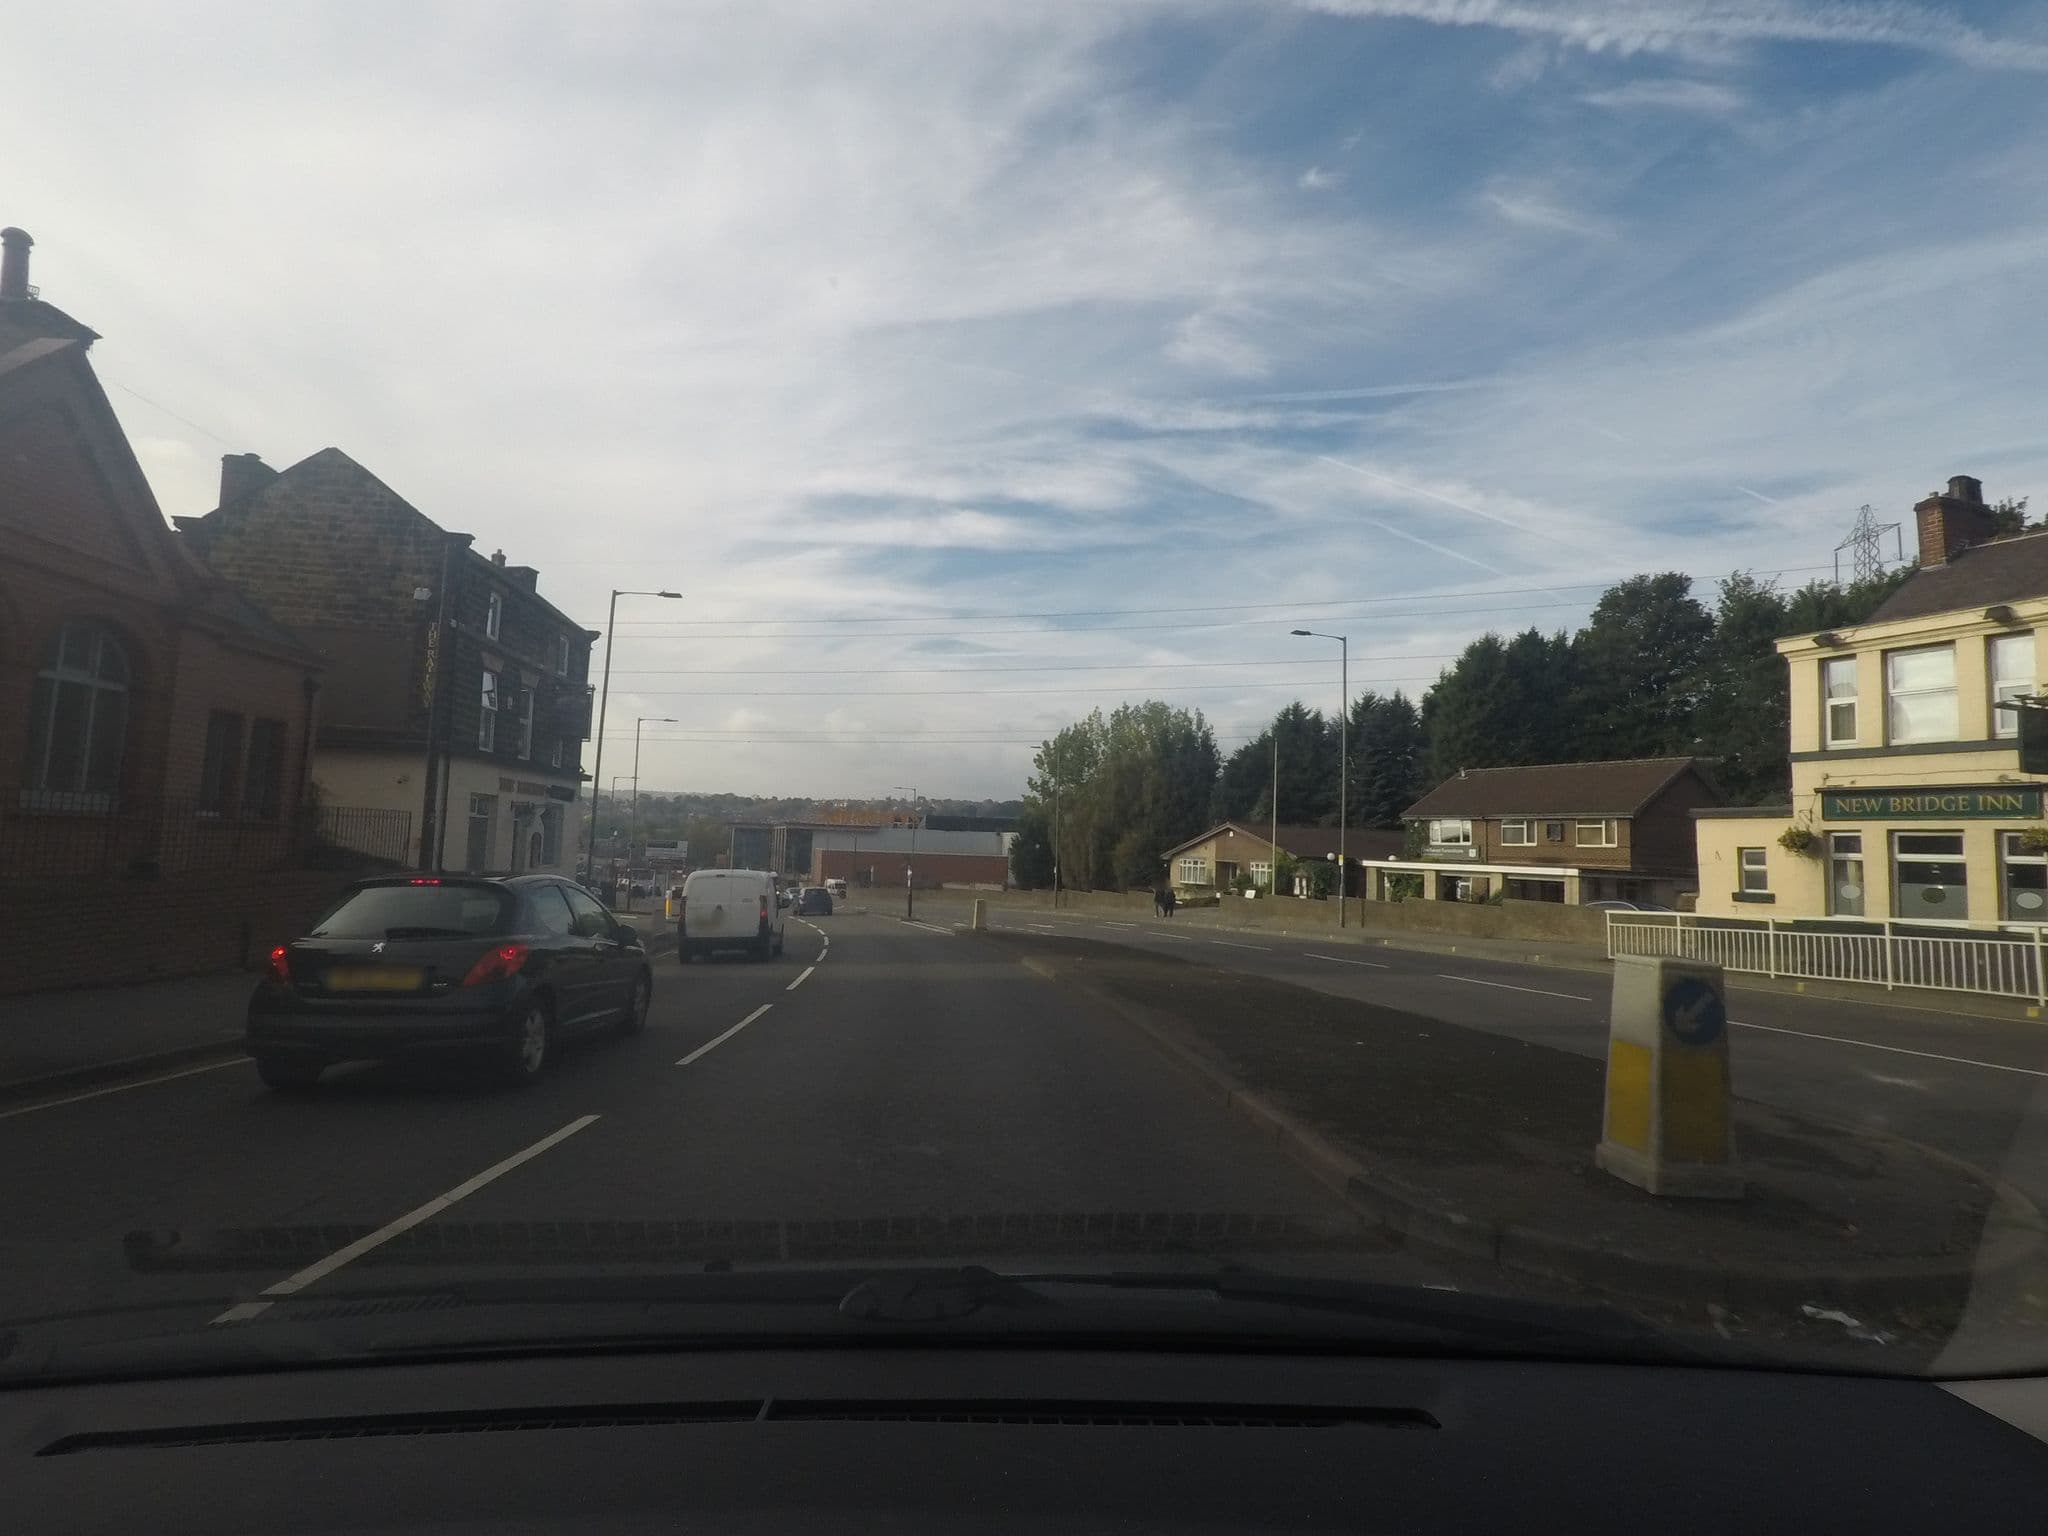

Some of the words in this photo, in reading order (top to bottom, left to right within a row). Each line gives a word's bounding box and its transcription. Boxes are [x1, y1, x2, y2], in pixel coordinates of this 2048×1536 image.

[1835, 797, 1883, 813] NEW
[1889, 795, 1969, 812] BRIDGE
[1978, 794, 2024, 811] INN
